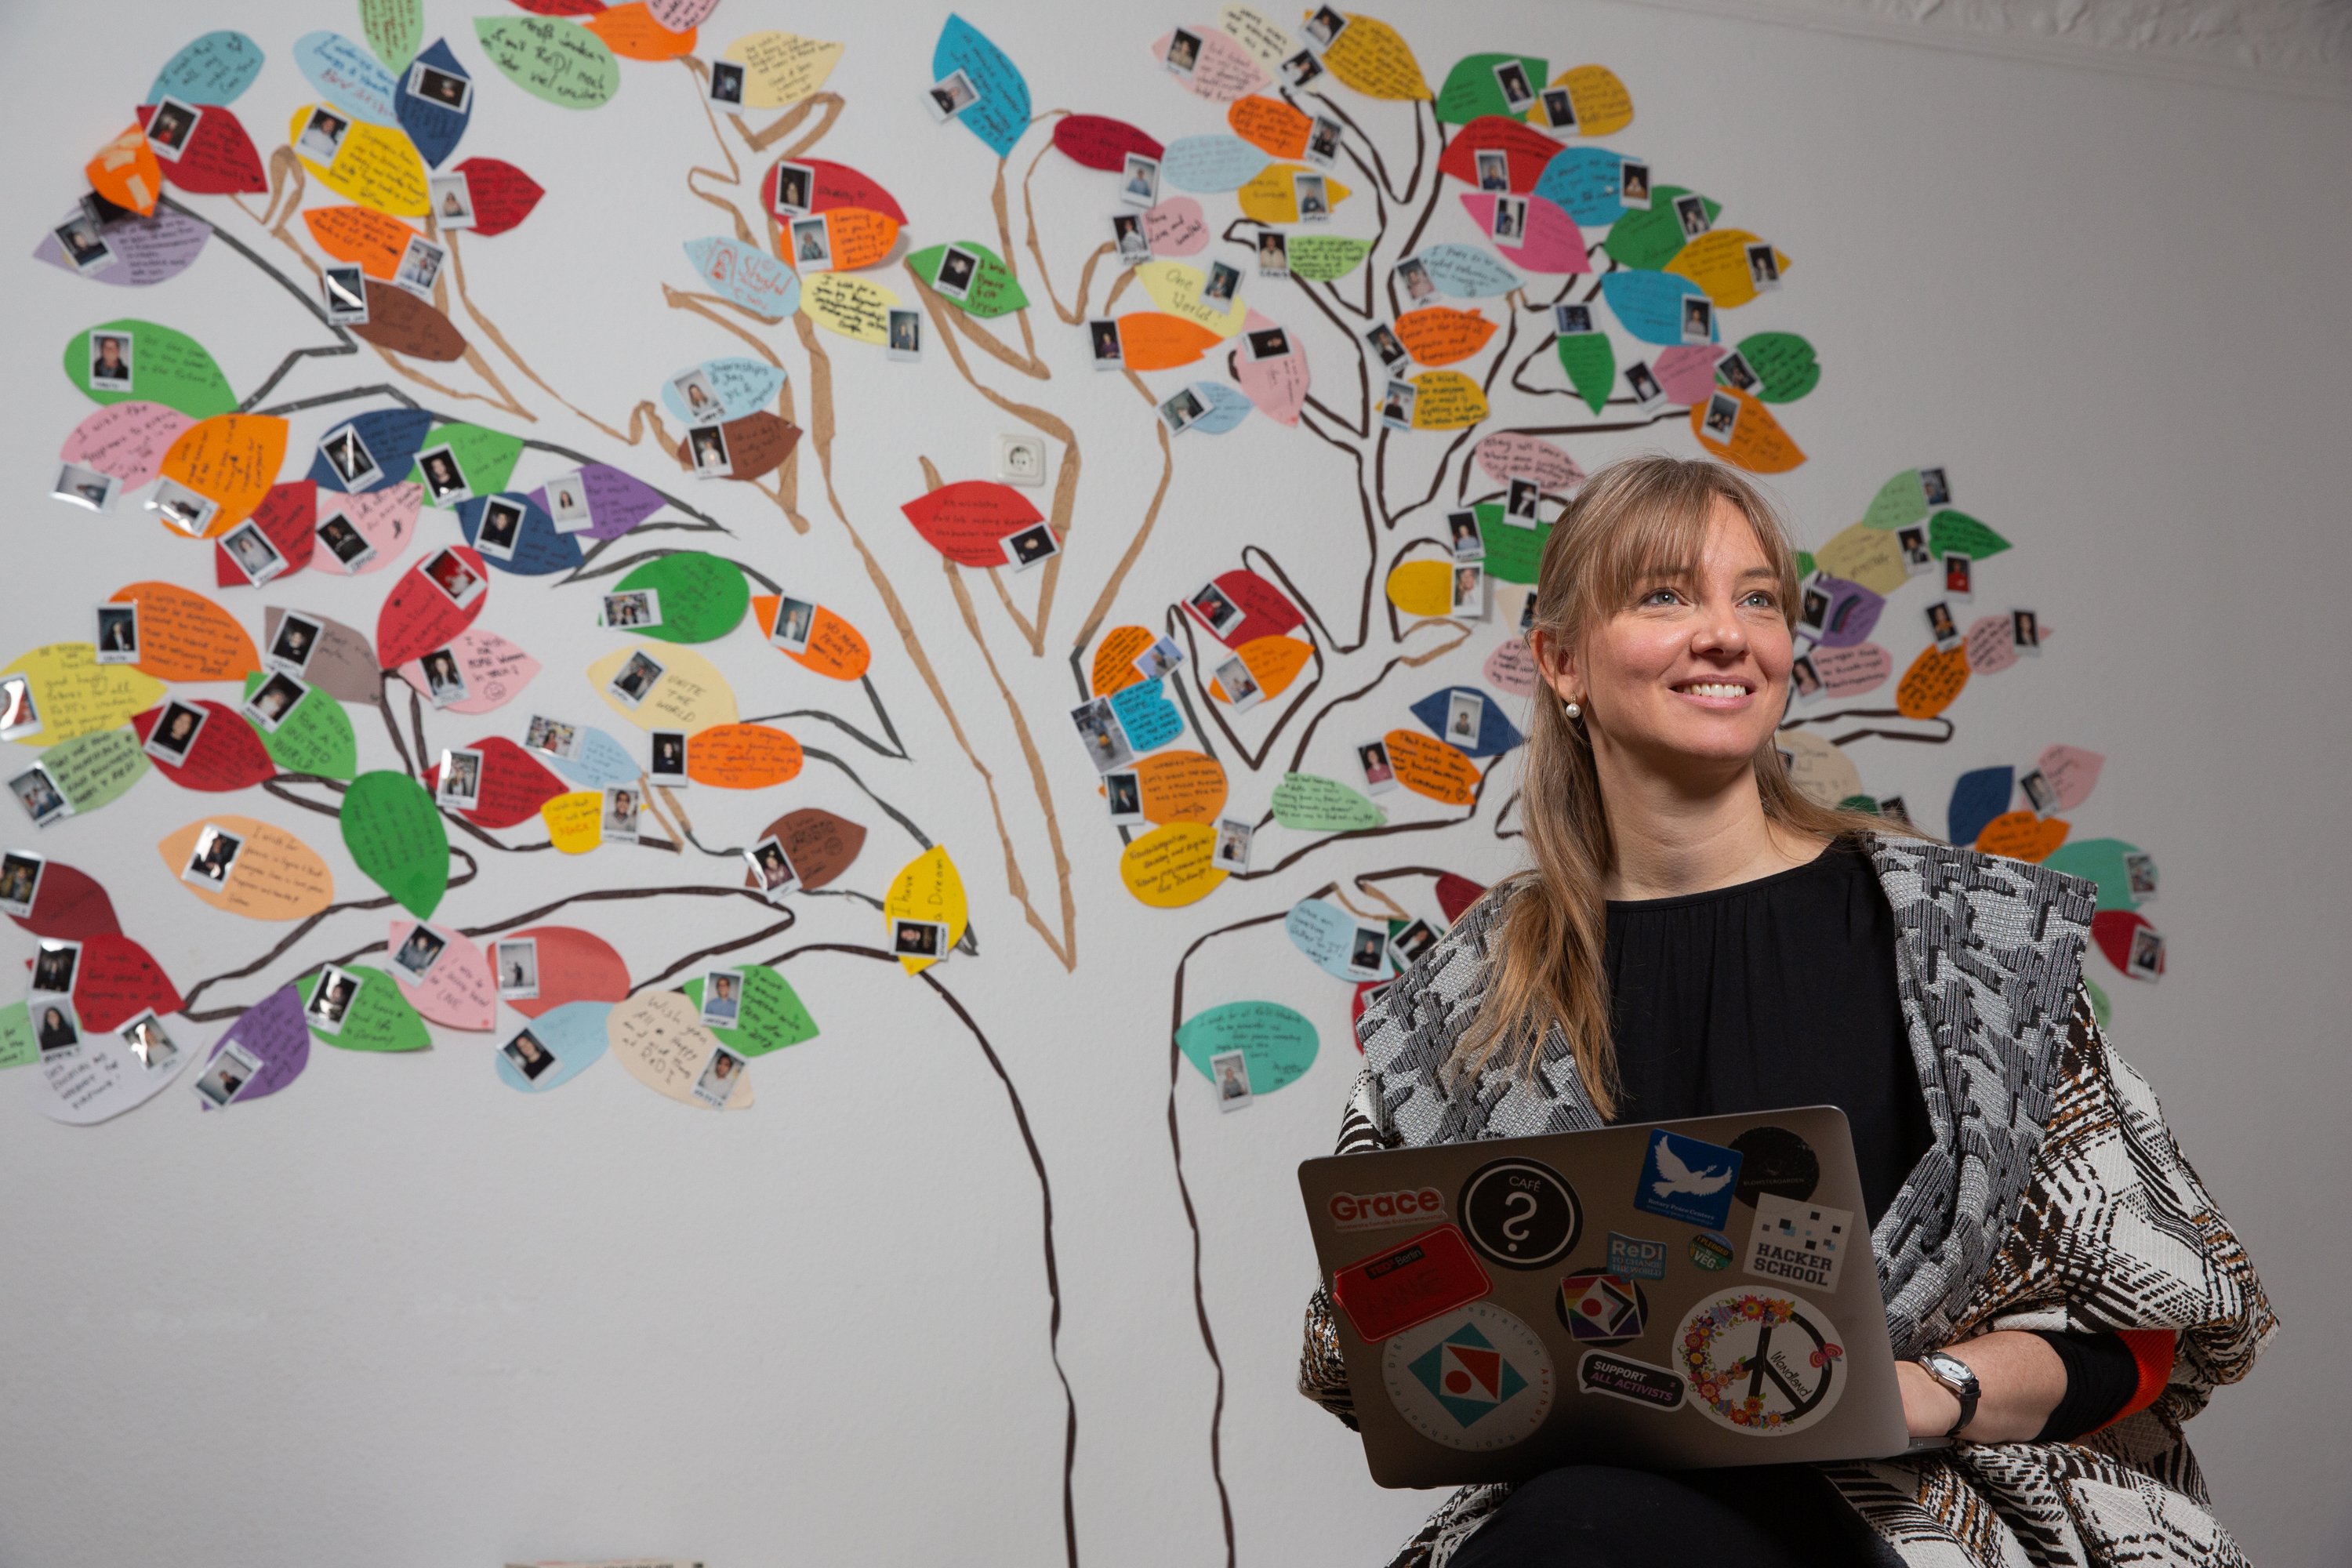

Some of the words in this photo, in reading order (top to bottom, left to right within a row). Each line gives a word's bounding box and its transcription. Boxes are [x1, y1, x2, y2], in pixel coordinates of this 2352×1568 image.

[1165, 268, 1194, 290] One
[666, 673, 708, 699] UNITE
[666, 688, 695, 707] THE
[655, 700, 697, 724] WORLD
[648, 996, 682, 1025] Wish
[1508, 1175, 1542, 1192] CAFÉ
[1330, 1191, 1440, 1221] Grace
[1648, 1198, 1670, 1210] Rotary
[1670, 1203, 1690, 1214] Peace
[1689, 1209, 1715, 1221] Centers
[1612, 1240, 1663, 1261] ReDI
[1700, 1236, 1730, 1257] PLEDGED
[1756, 1243, 1832, 1272] HACKER
[1612, 1256, 1625, 1265] TO
[1626, 1258, 1662, 1269] CHANGE
[1693, 1250, 1717, 1269] VEG
[1753, 1257, 1828, 1287] SCHOOL
[1593, 1360, 1648, 1382] SUPPORT
[1770, 1350, 1813, 1398] Wendland
[1529, 1367, 1550, 1424] Aarhus
[1591, 1372, 1614, 1386] ALL
[1614, 1377, 1675, 1403] ACTIVISTS
